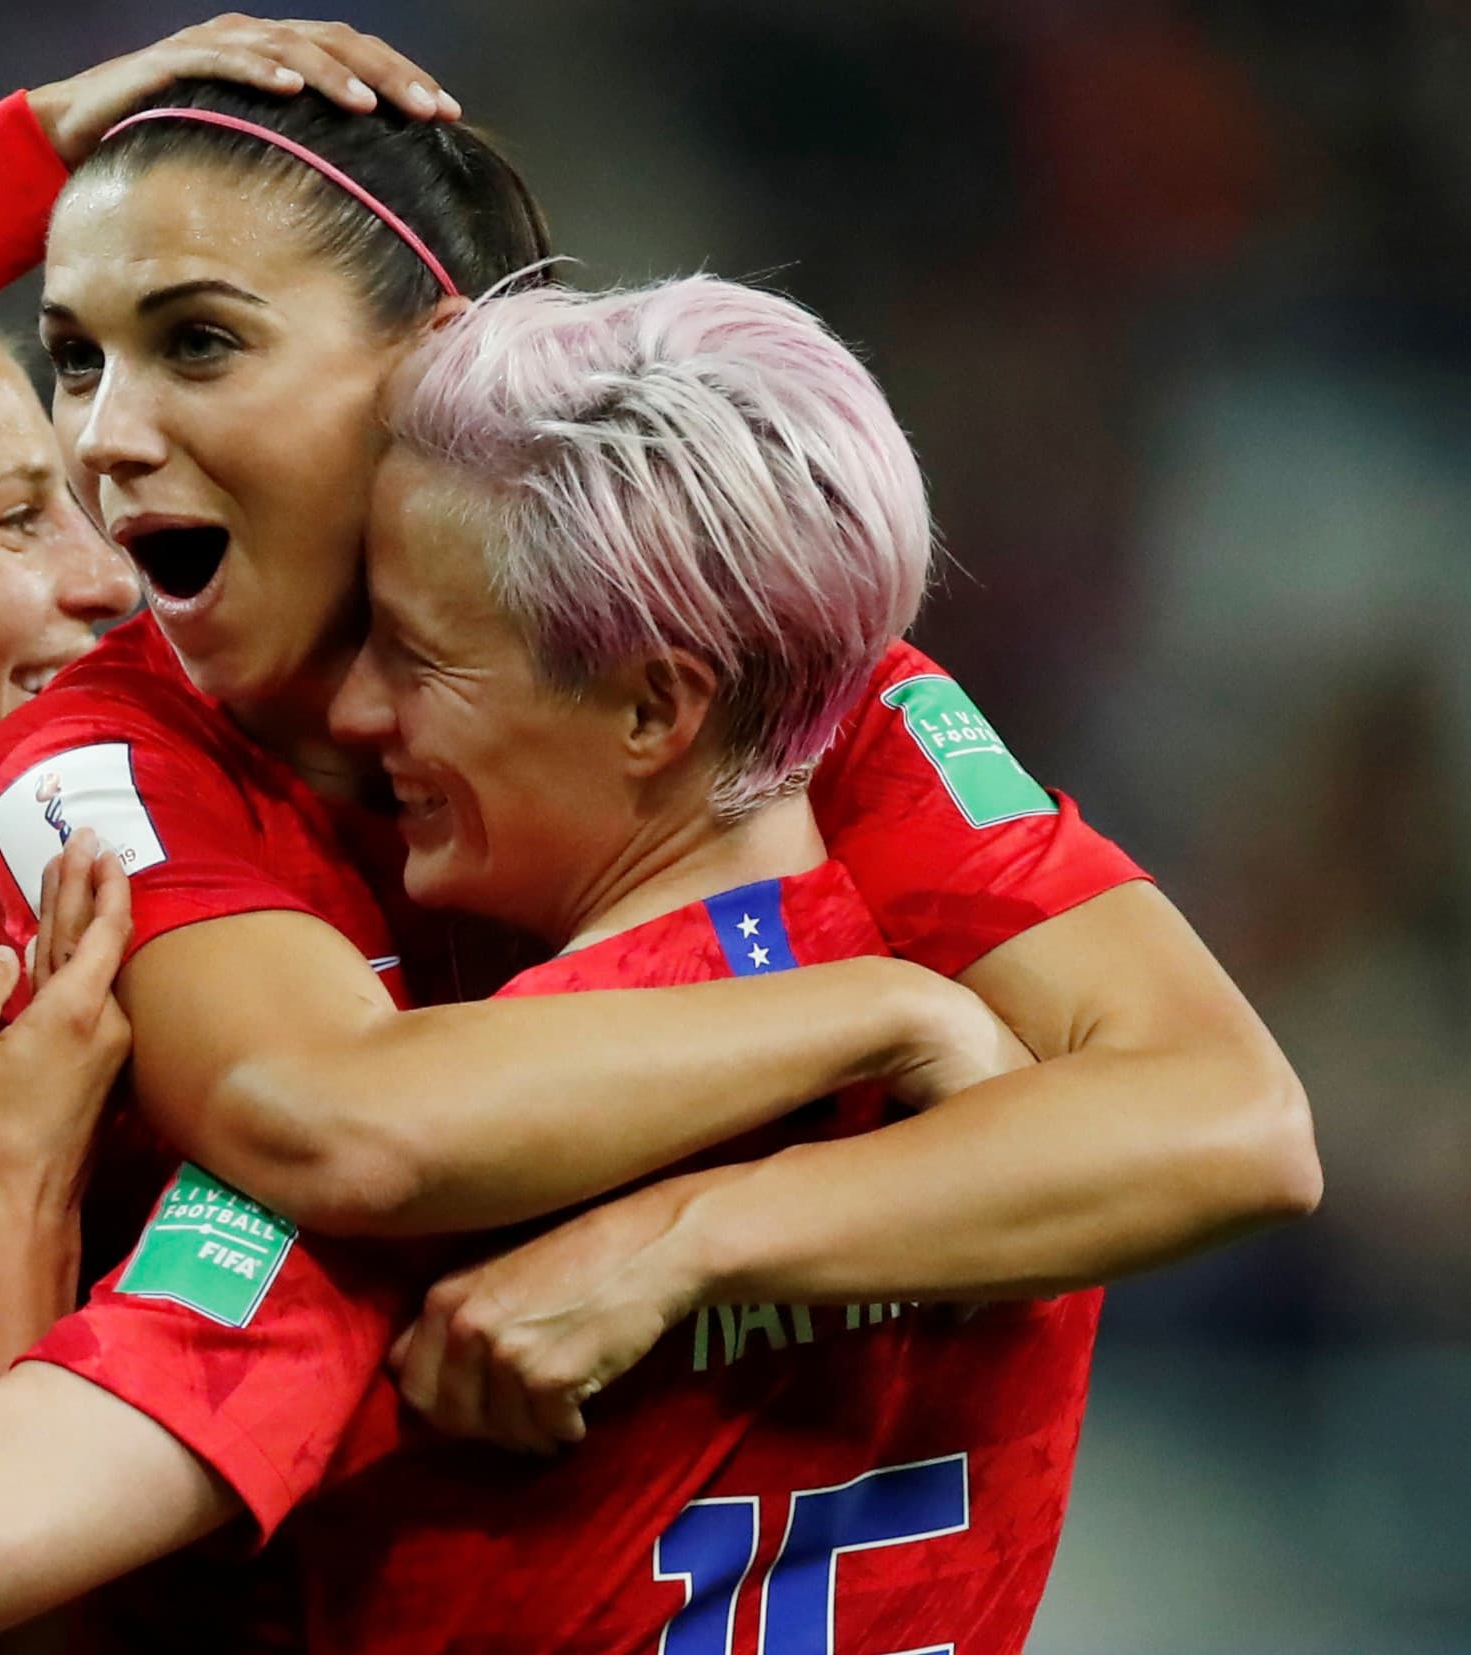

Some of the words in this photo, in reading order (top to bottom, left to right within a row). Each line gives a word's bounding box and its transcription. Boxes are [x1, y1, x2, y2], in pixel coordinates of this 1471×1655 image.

[117, 847, 137, 865] 19
[163, 1203, 275, 1241] FOOTBALL
[197, 1241, 259, 1280] FIFA
